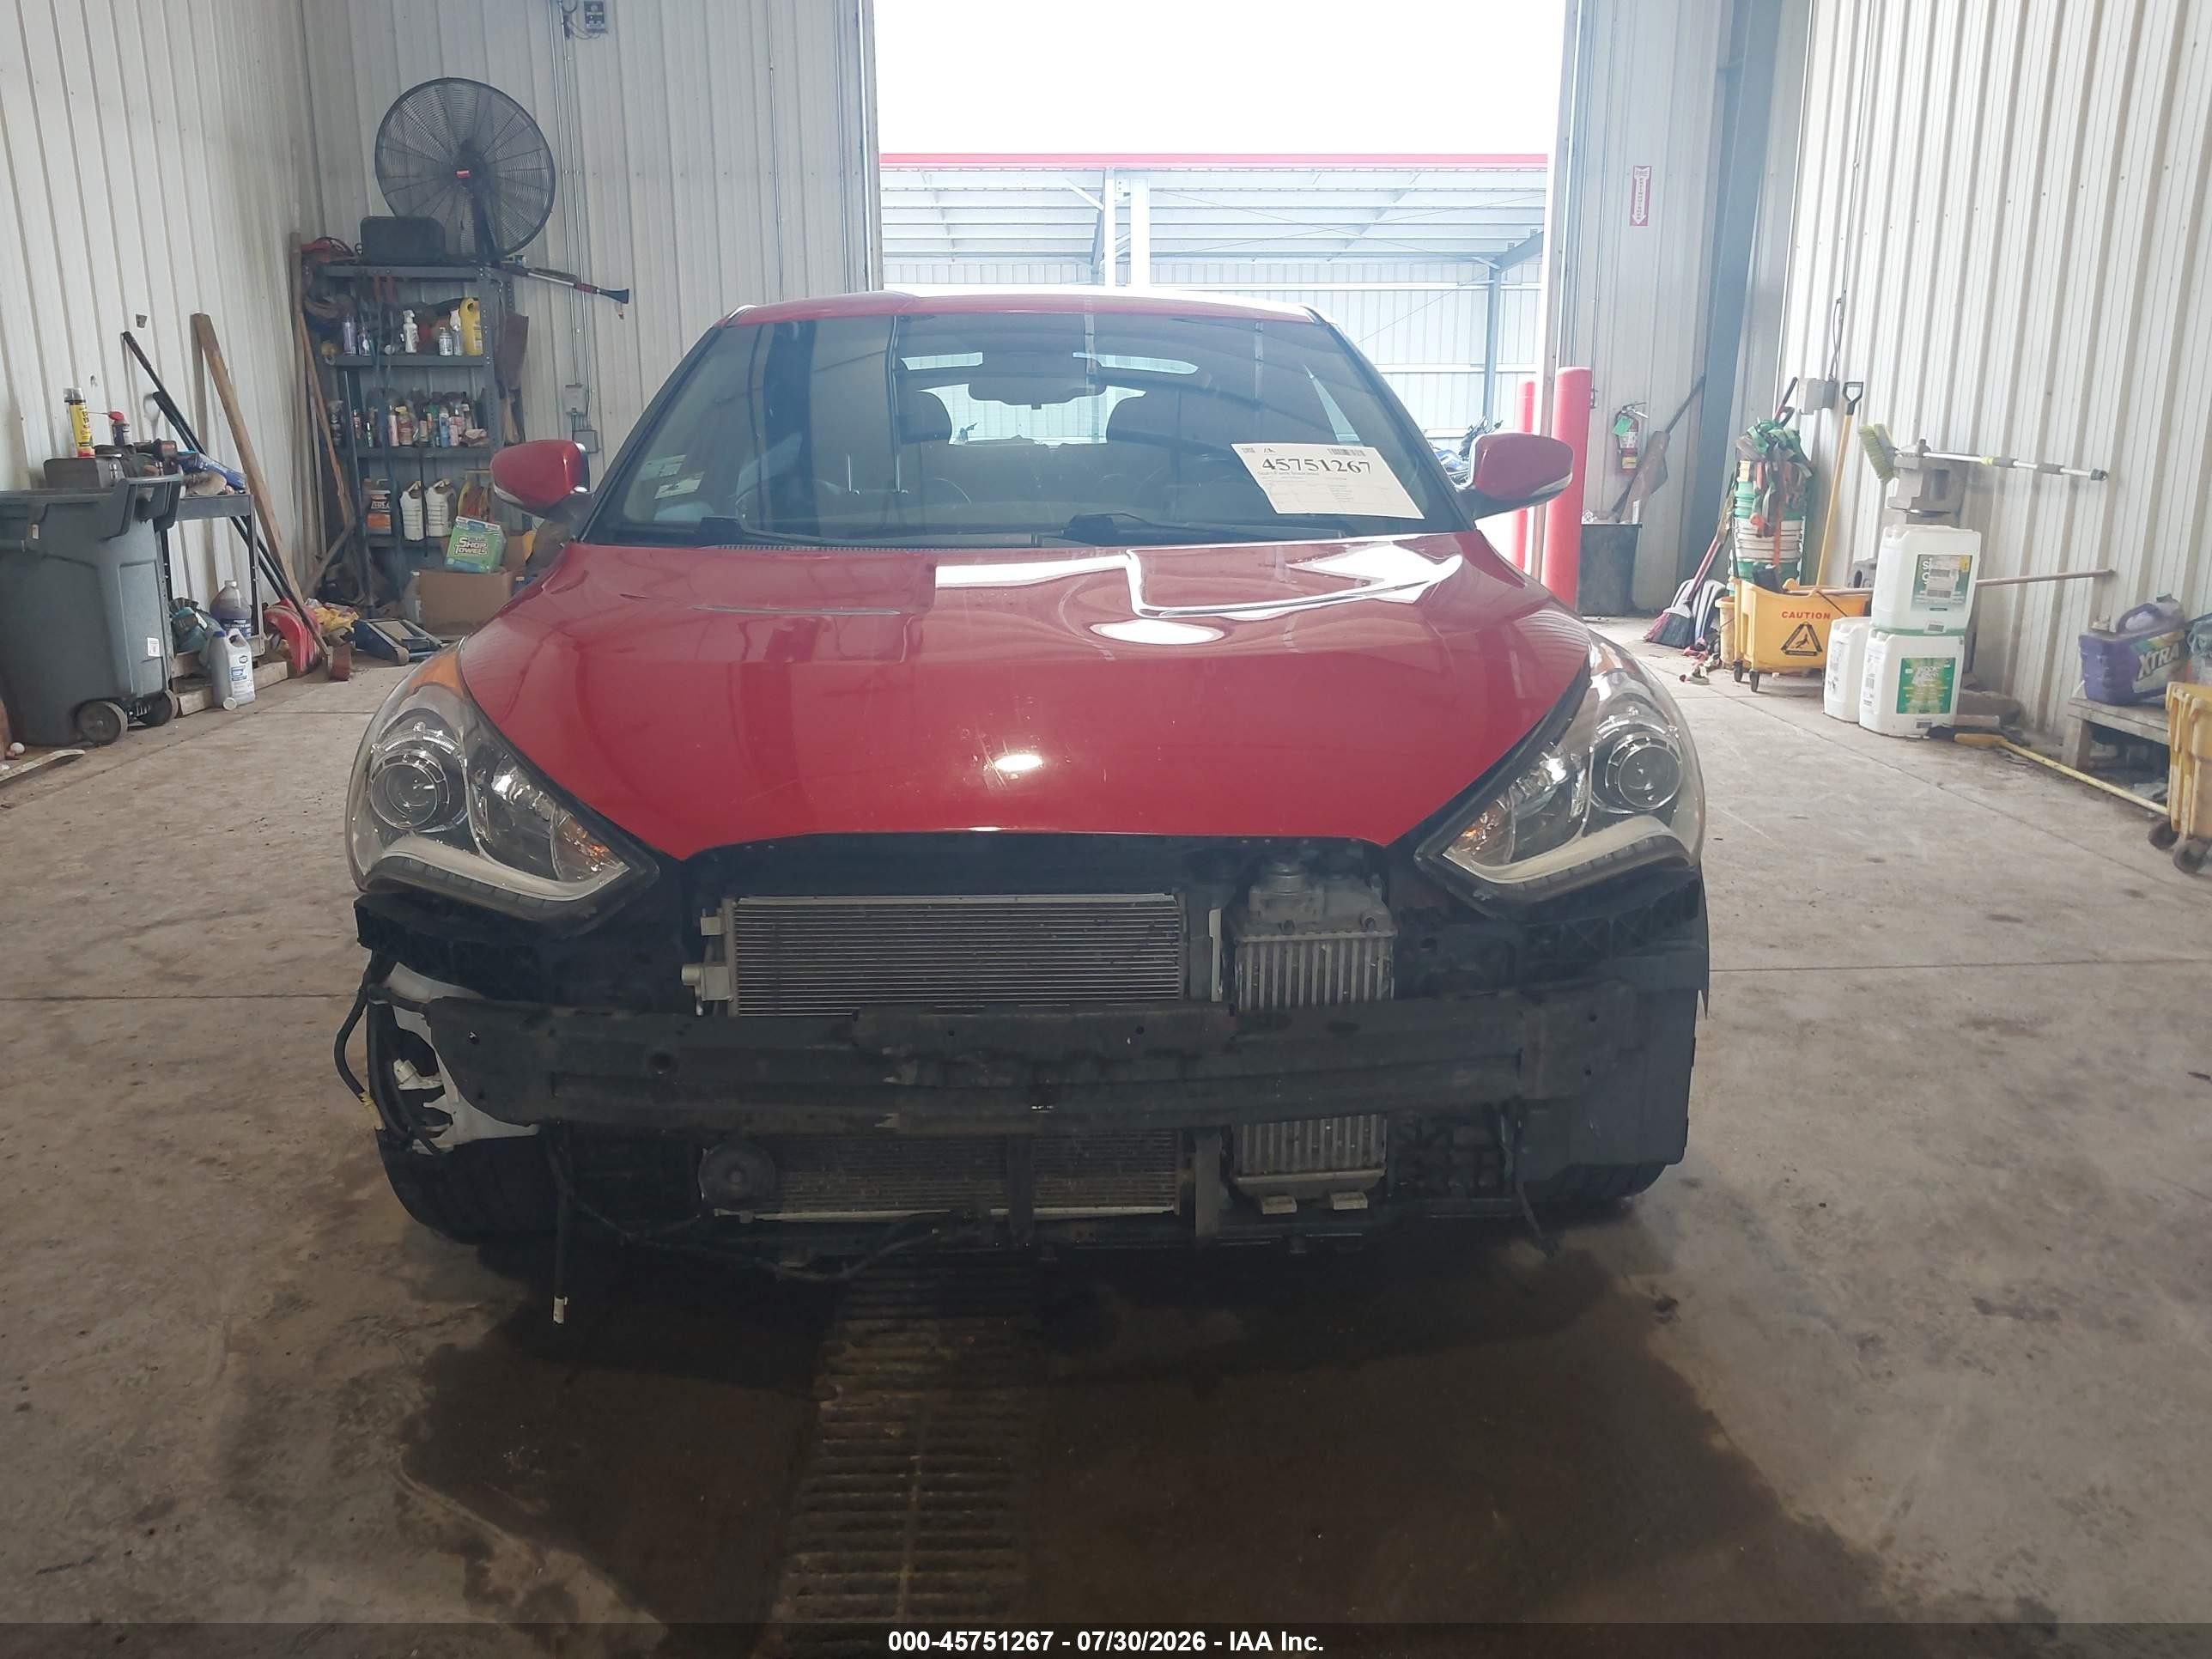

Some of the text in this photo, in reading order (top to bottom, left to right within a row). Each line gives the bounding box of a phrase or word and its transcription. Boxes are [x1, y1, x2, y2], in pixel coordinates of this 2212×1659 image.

[1262, 458, 1371, 474] 45751267
[453, 542, 489, 556] TOWELS
[458, 536, 488, 550] SHOP
[1781, 611, 1832, 620] CAUTION
[2136, 642, 2179, 681] XTRA
